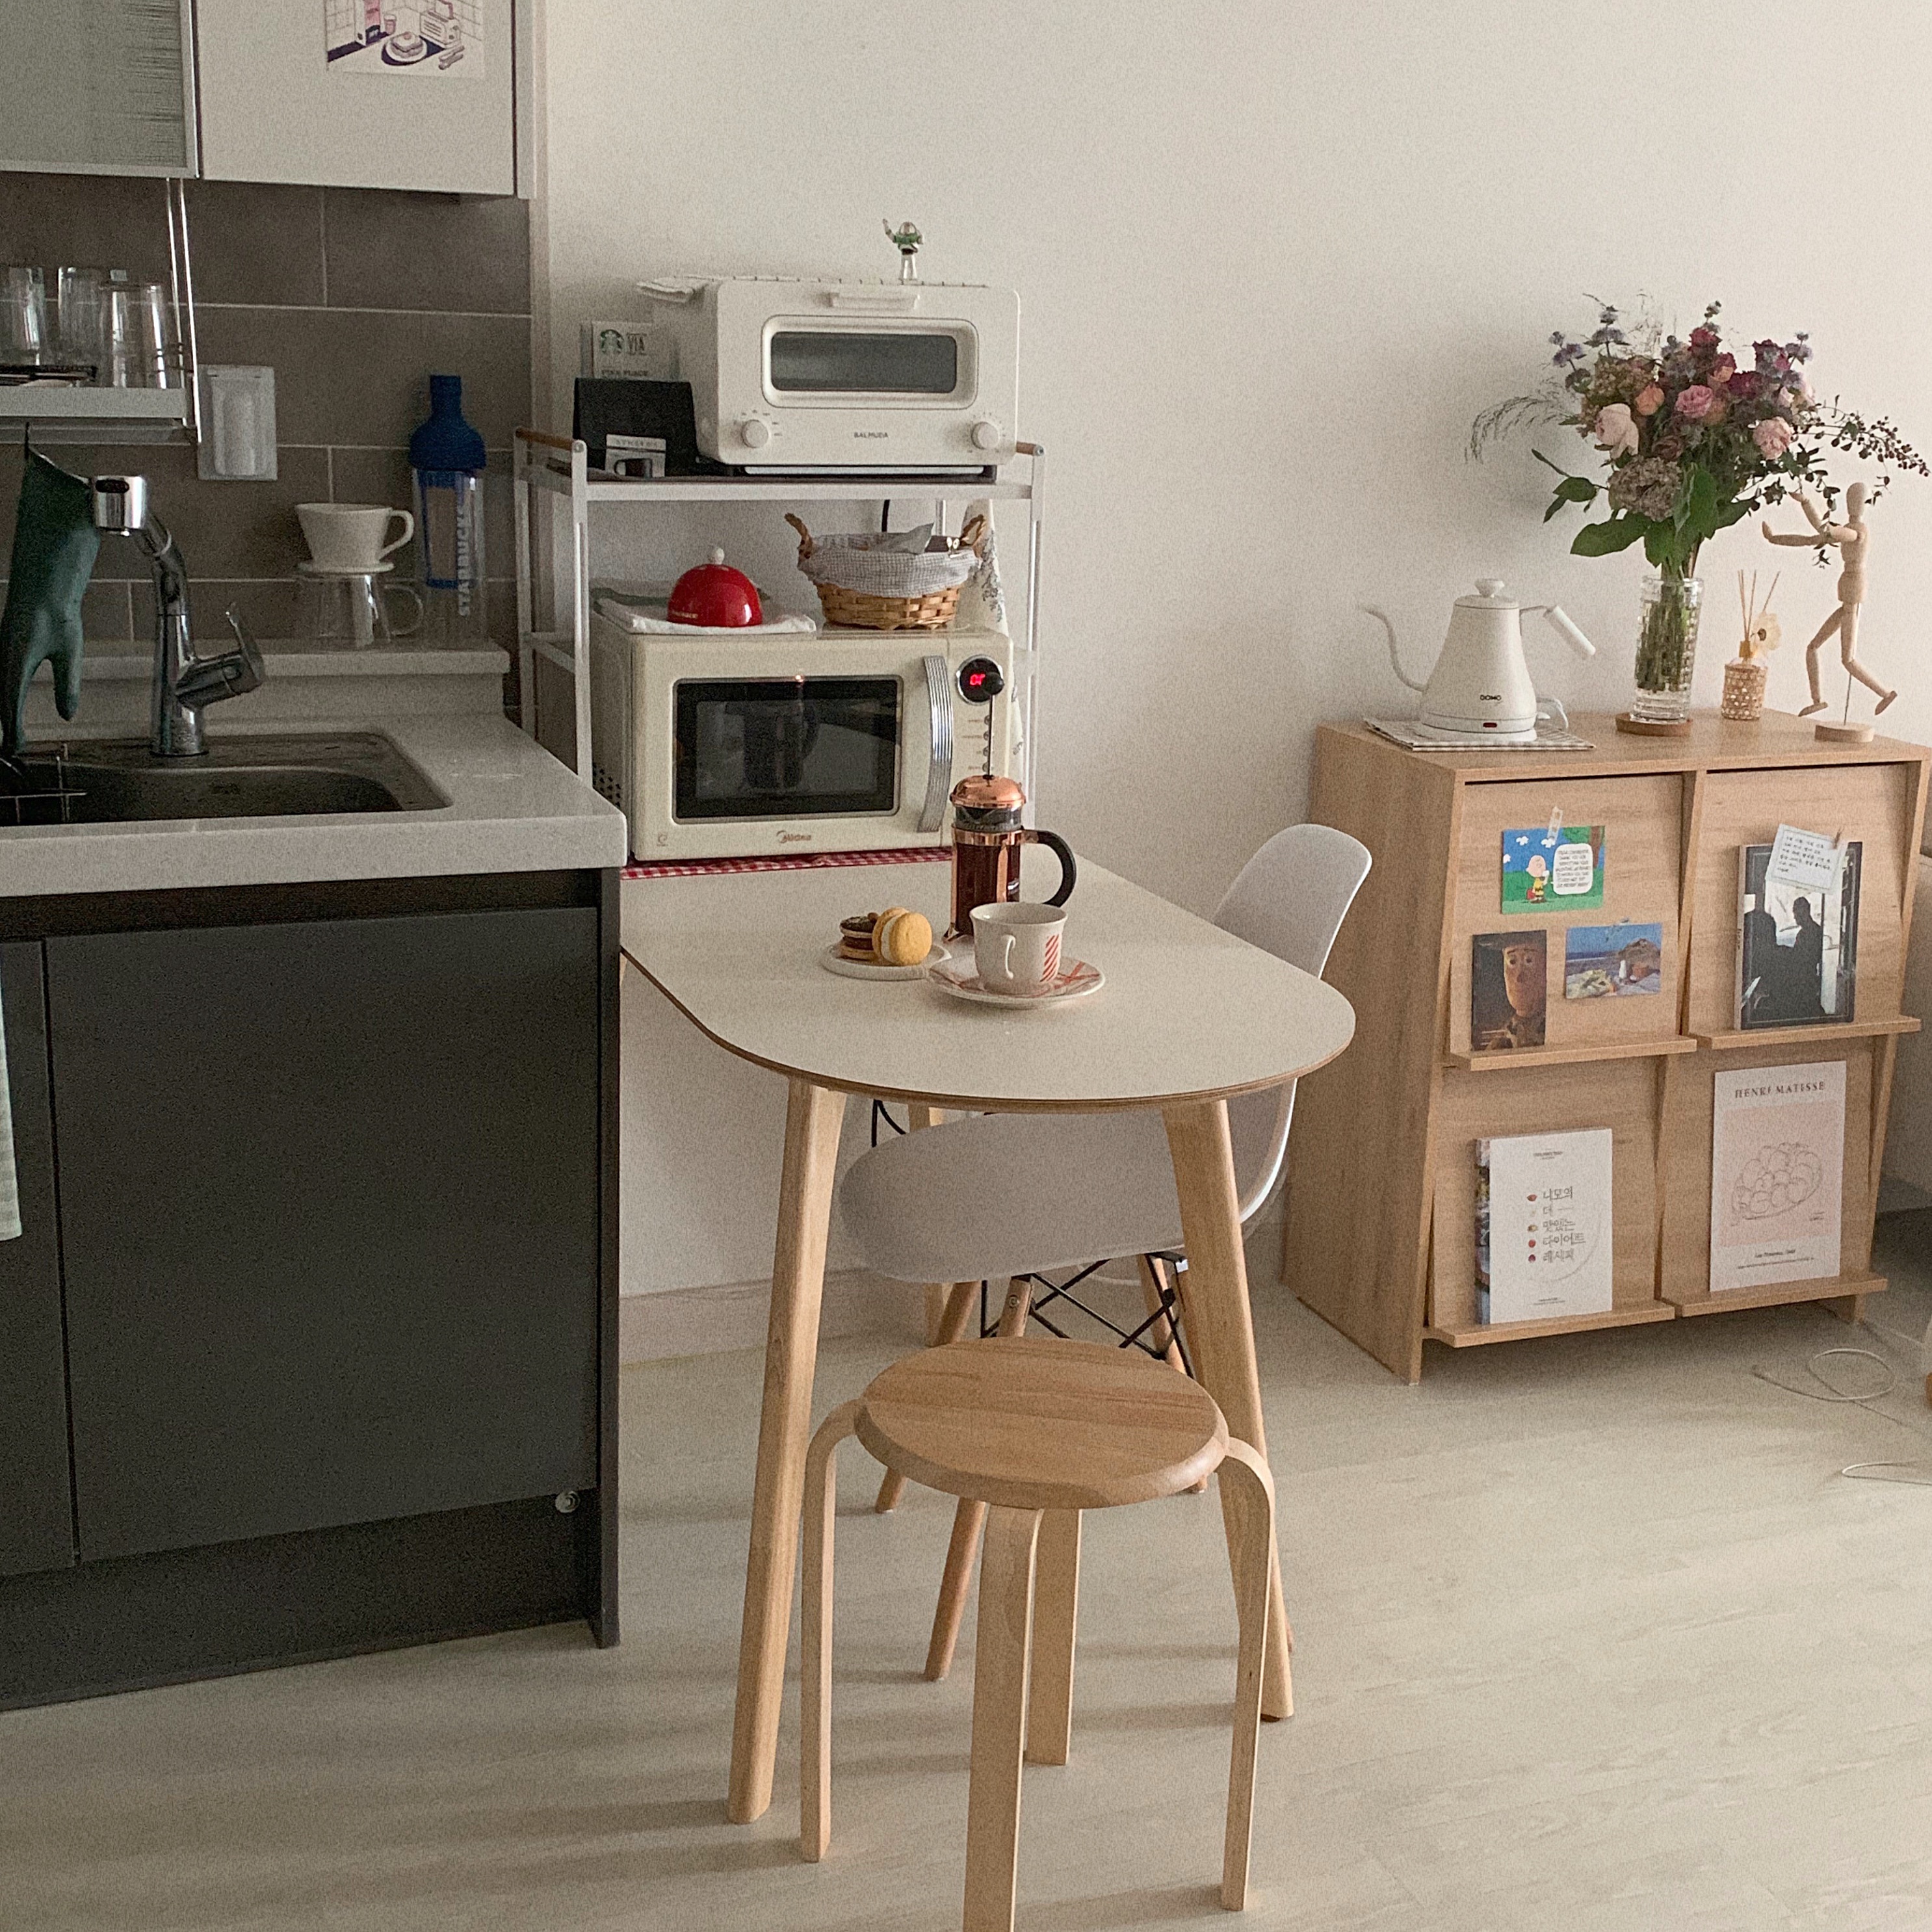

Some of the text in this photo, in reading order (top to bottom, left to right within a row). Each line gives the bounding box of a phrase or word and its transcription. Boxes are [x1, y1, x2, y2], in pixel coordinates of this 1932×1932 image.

[1735, 1081, 1825, 1099] HENRI MATISSE
[1543, 1186, 1573, 1201] 나모의
[1543, 1233, 1587, 1247] 다이어트
